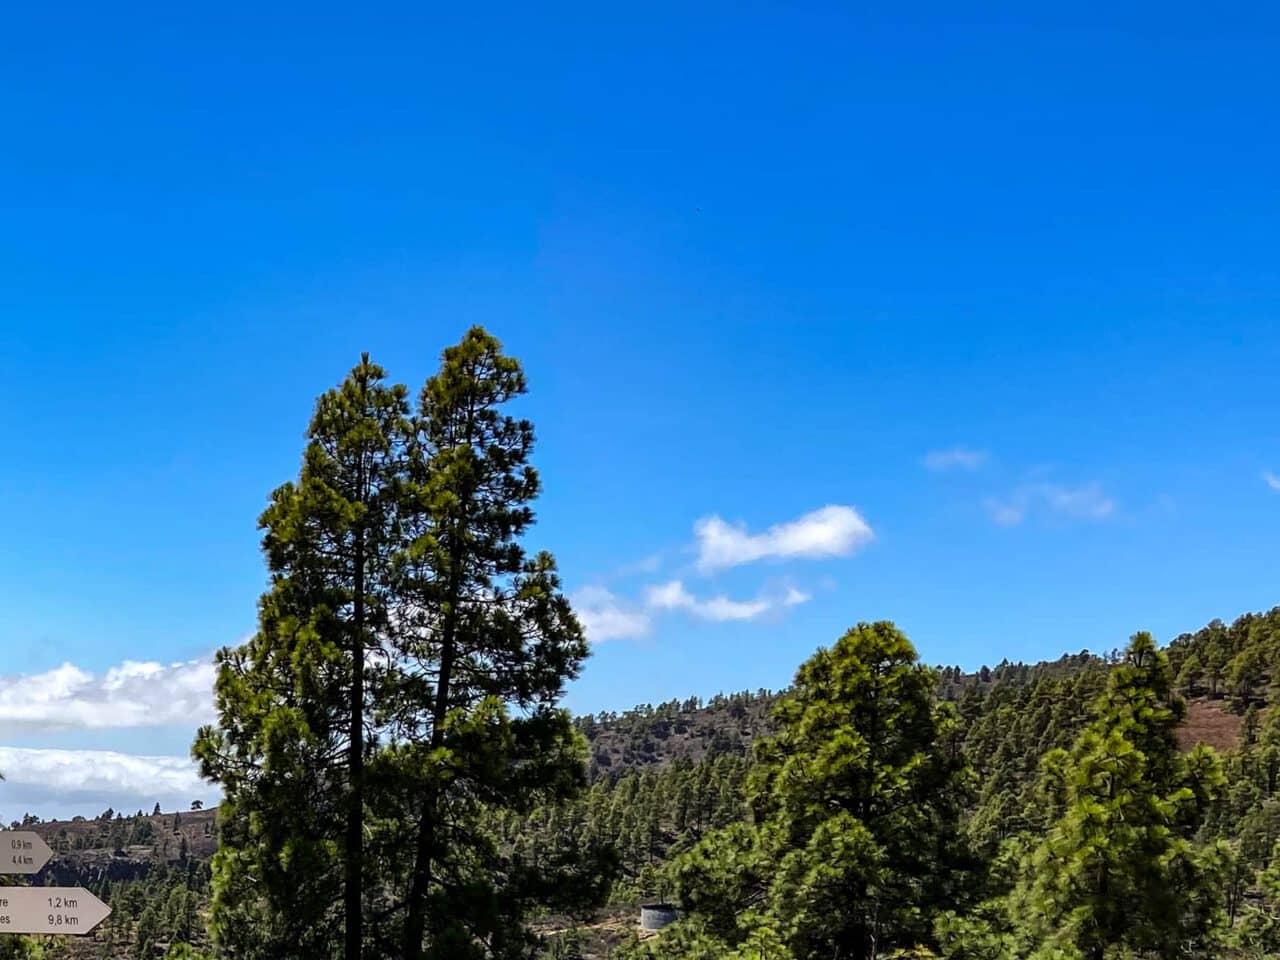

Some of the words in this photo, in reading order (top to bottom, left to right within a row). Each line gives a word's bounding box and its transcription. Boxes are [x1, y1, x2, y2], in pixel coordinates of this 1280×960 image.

[22, 840, 33, 849] km
[23, 855, 34, 865] km
[63, 897, 78, 908] km
[63, 914, 79, 925] km
